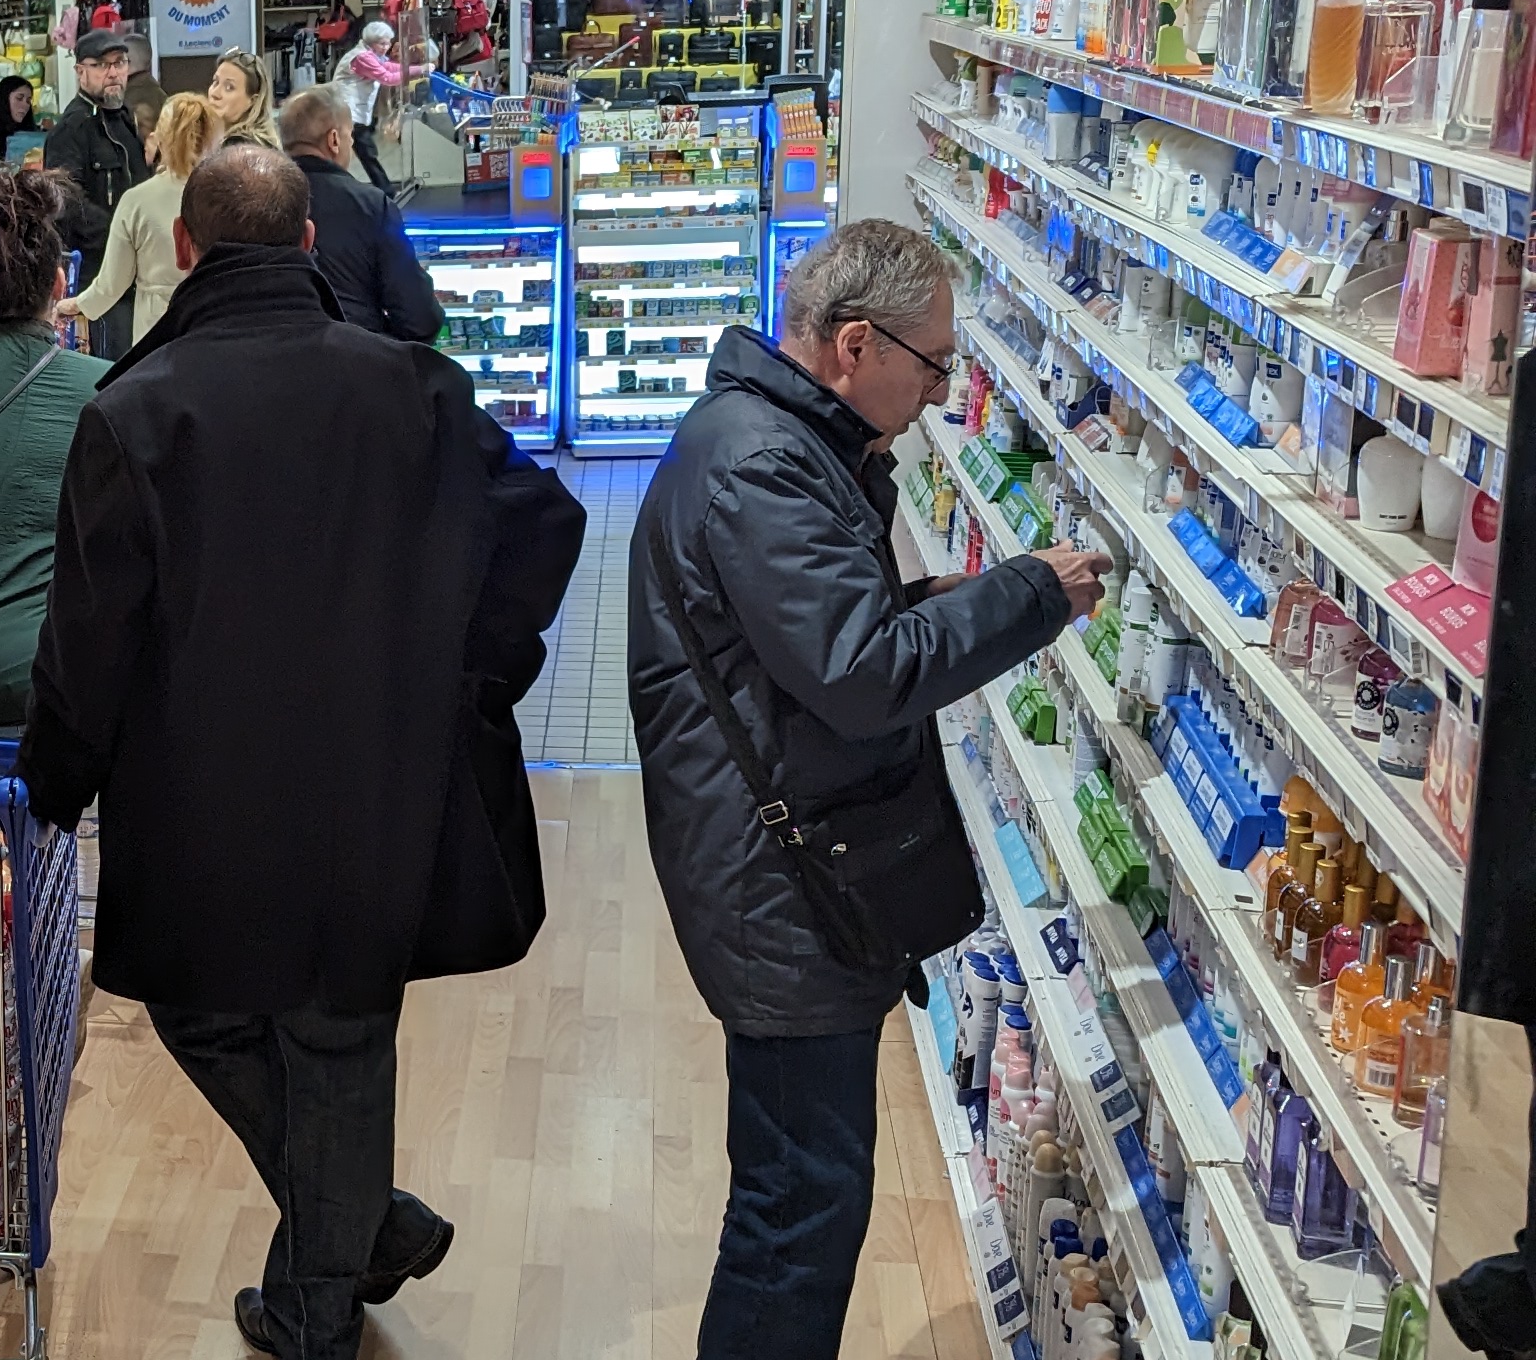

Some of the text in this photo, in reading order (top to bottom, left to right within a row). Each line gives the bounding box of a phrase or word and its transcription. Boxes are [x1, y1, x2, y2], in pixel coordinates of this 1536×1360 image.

[168, 4, 231, 27] DU MOMENT
[1079, 1015, 1095, 1036] Dove
[1090, 1041, 1106, 1062] Dove
[981, 1205, 995, 1228] Dove
[990, 1238, 1004, 1260] Dove
